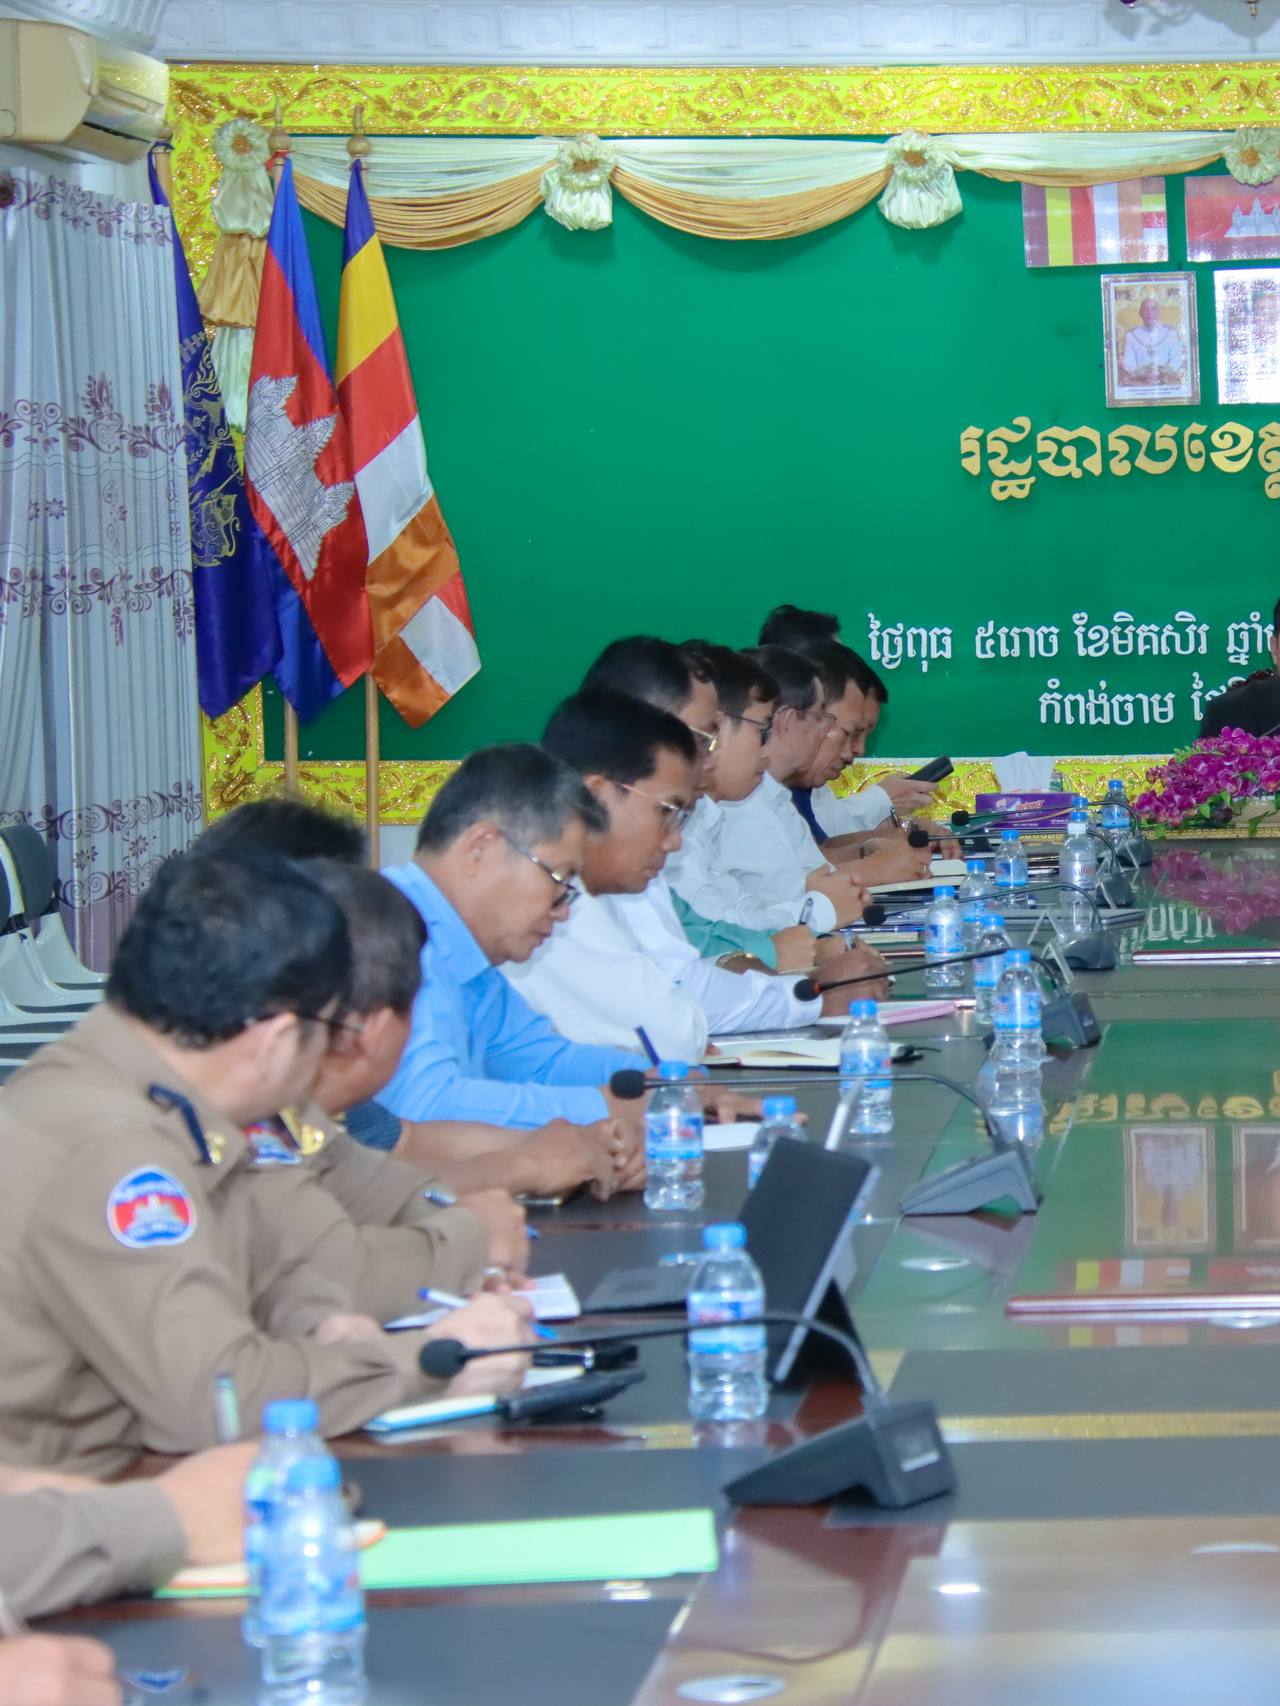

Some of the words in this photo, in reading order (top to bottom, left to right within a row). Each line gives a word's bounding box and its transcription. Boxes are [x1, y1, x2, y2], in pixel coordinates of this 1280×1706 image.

[868, 613, 952, 672] ថ្ងៃពុធ
[975, 620, 1060, 659] ៥រោច
[1072, 610, 1210, 657] ខែមិគសិរ
[1038, 678, 1175, 725] កំពង់ចាម
